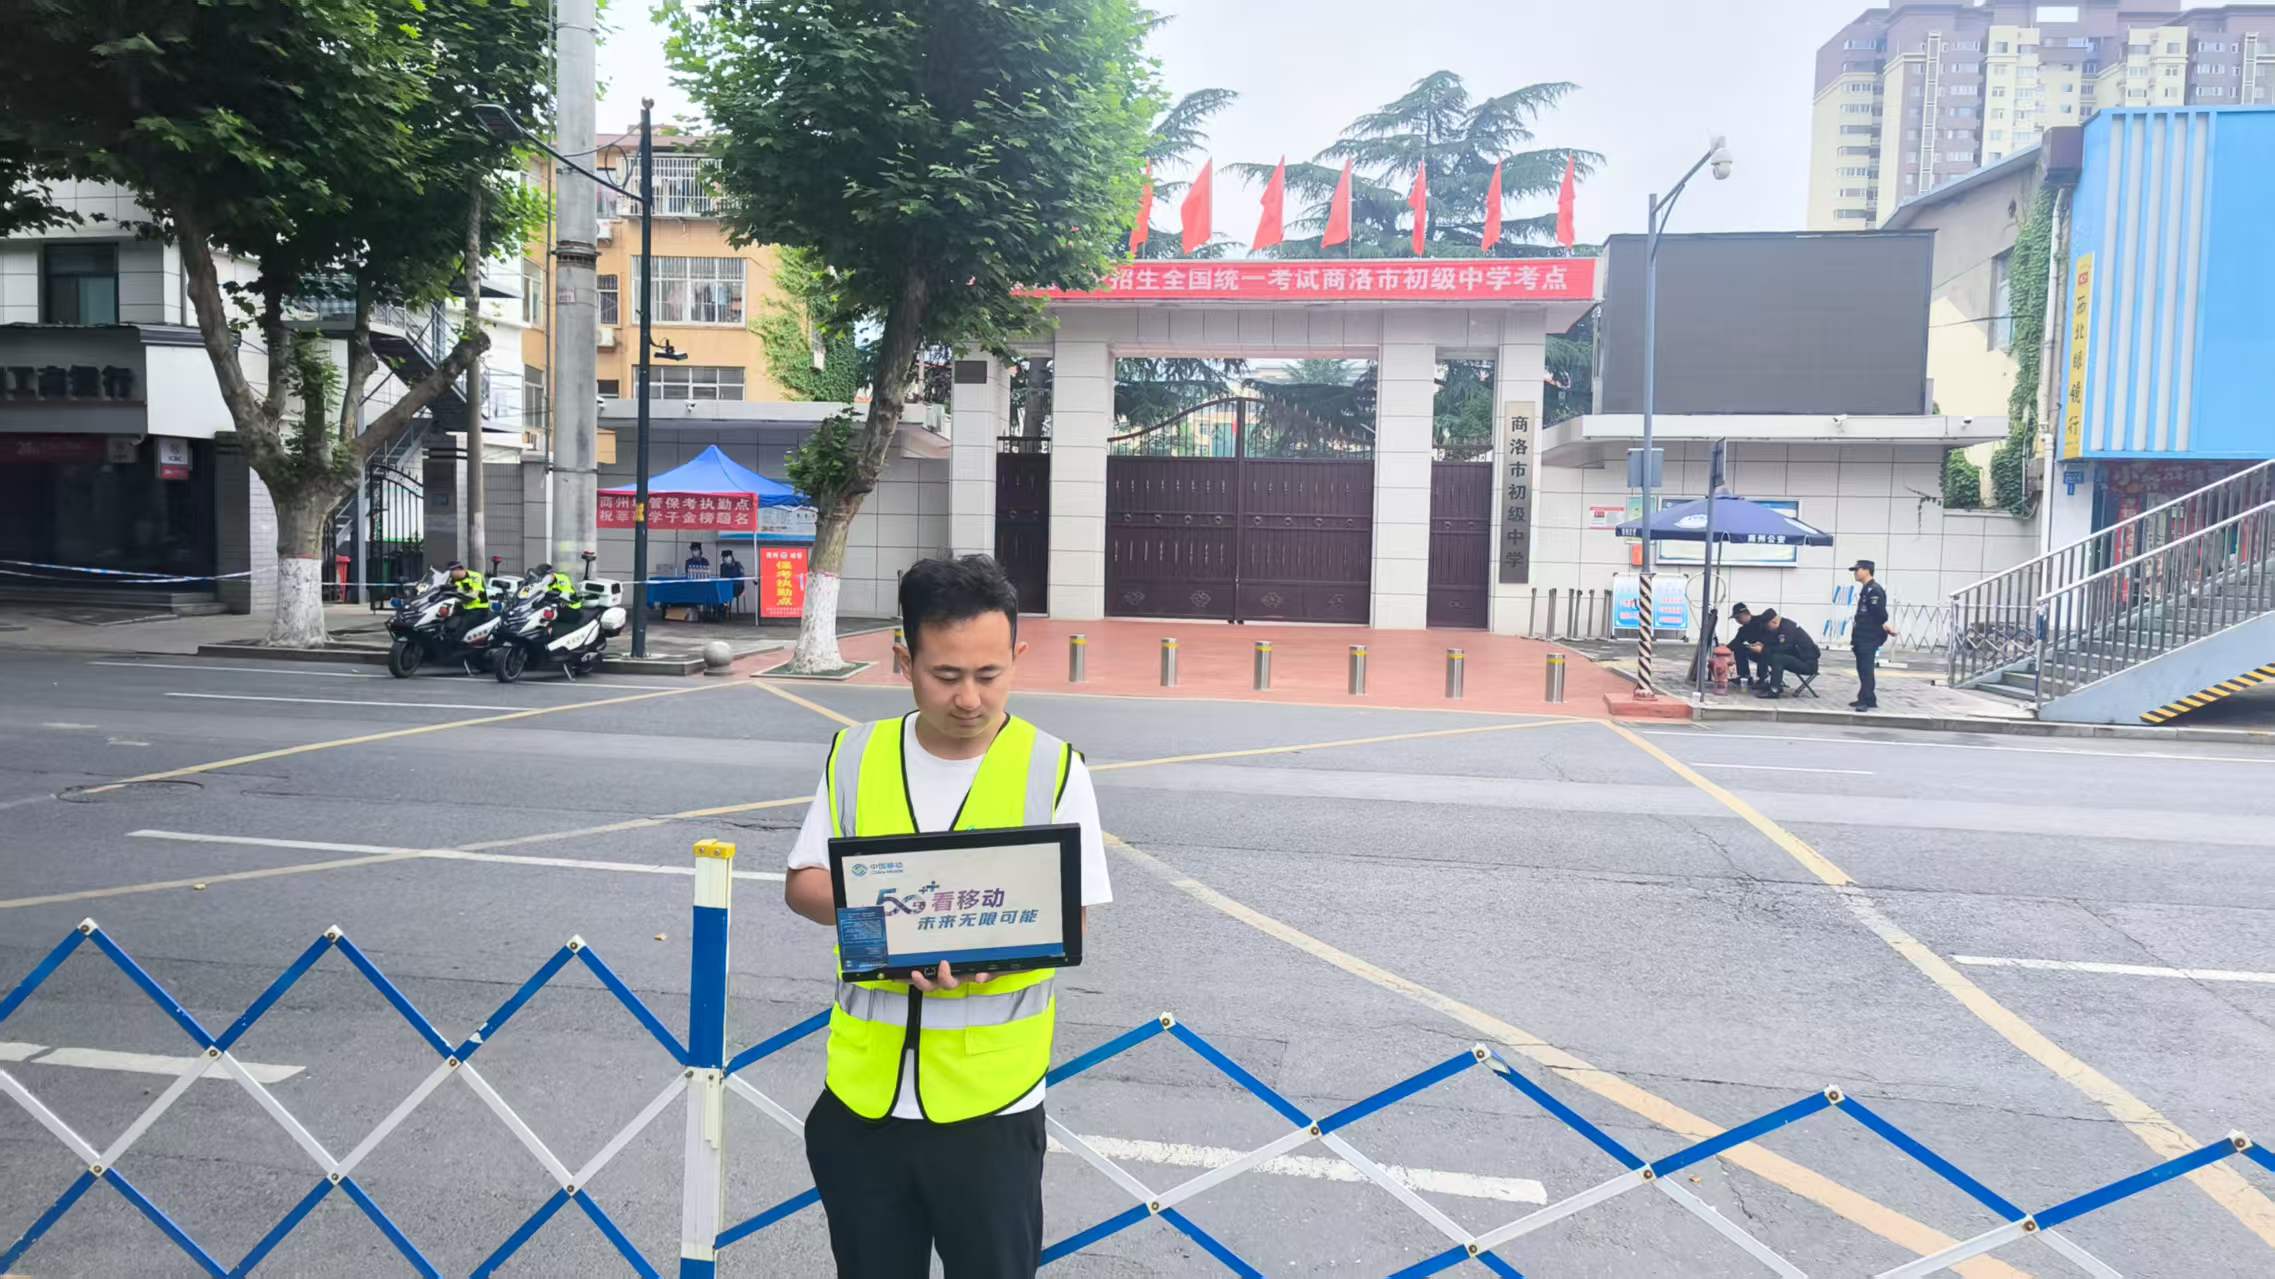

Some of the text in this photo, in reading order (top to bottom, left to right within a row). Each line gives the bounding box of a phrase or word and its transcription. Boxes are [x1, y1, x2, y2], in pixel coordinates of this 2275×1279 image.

[1098, 265, 1568, 291] 招生全国统一考试商洛市初级中学考点
[1505, 415, 1529, 568] 商洛市初级中学
[917, 909, 1039, 931] 未来无限可能
